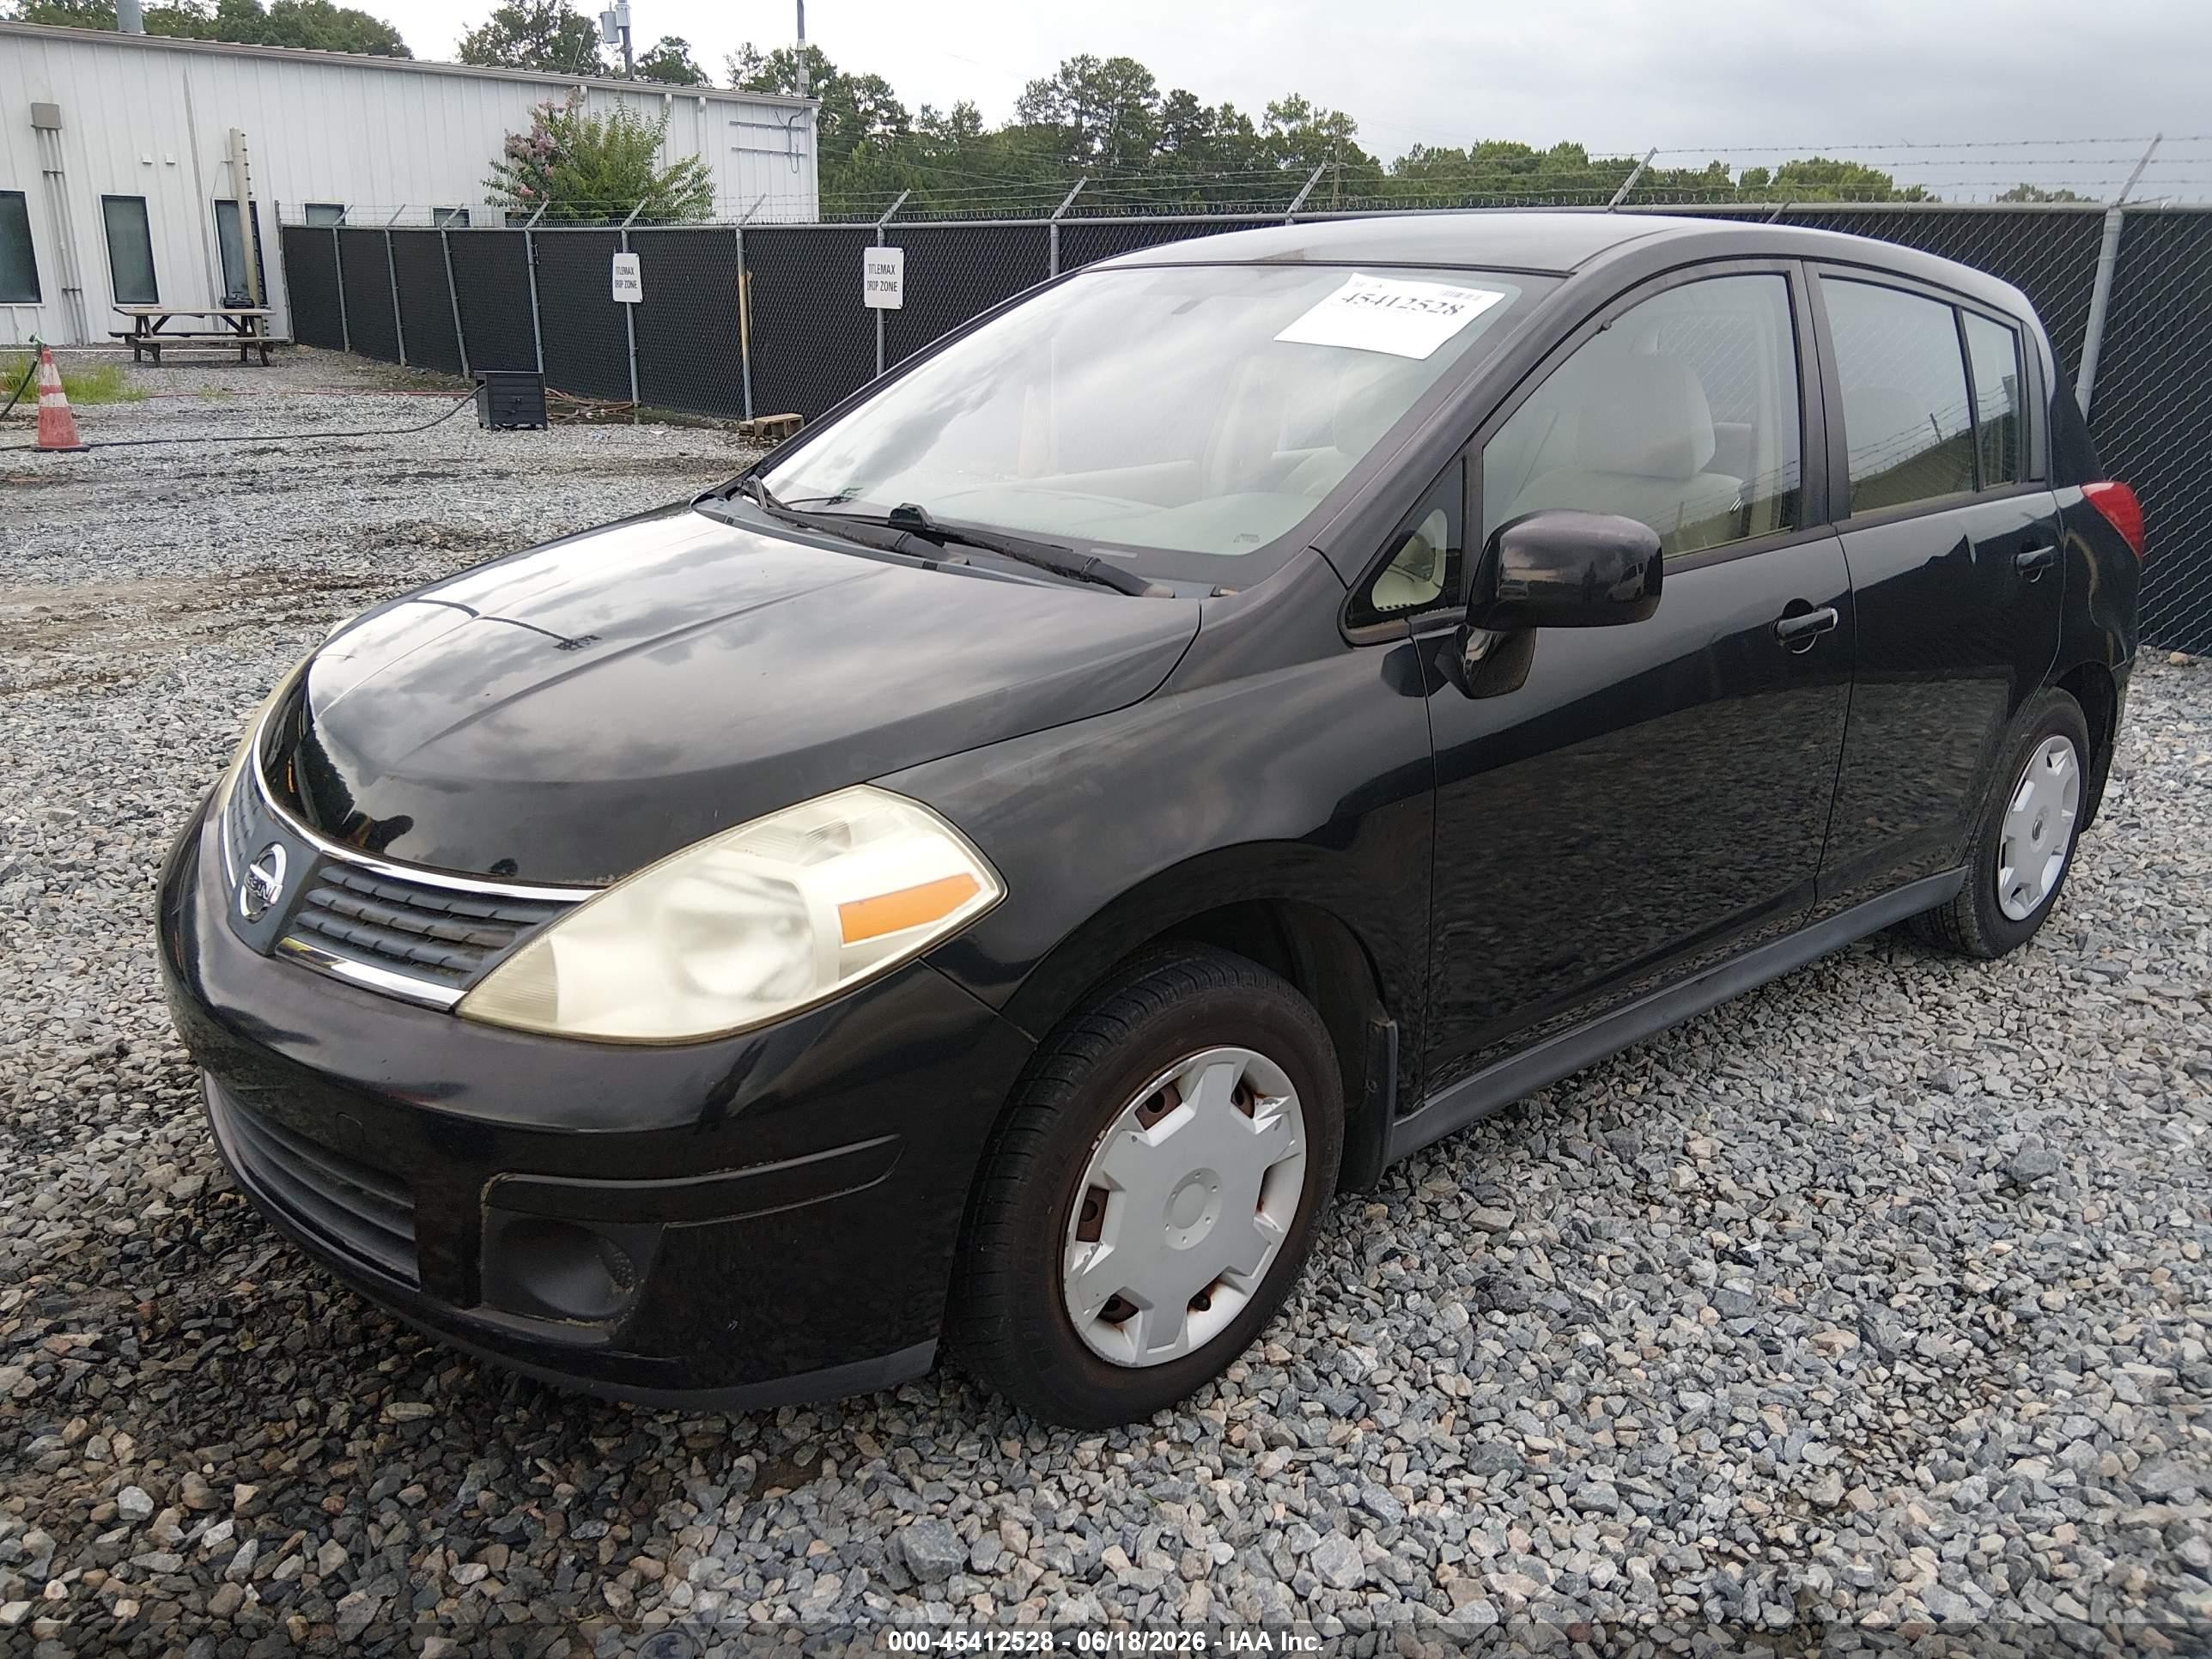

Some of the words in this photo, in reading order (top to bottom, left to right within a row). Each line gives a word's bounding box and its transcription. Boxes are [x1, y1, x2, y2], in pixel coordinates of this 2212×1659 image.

[868, 264, 896, 275] TITLEMAX
[866, 280, 878, 291] DROP
[880, 281, 897, 292] ZONE
[1341, 292, 1465, 316] 45412528
